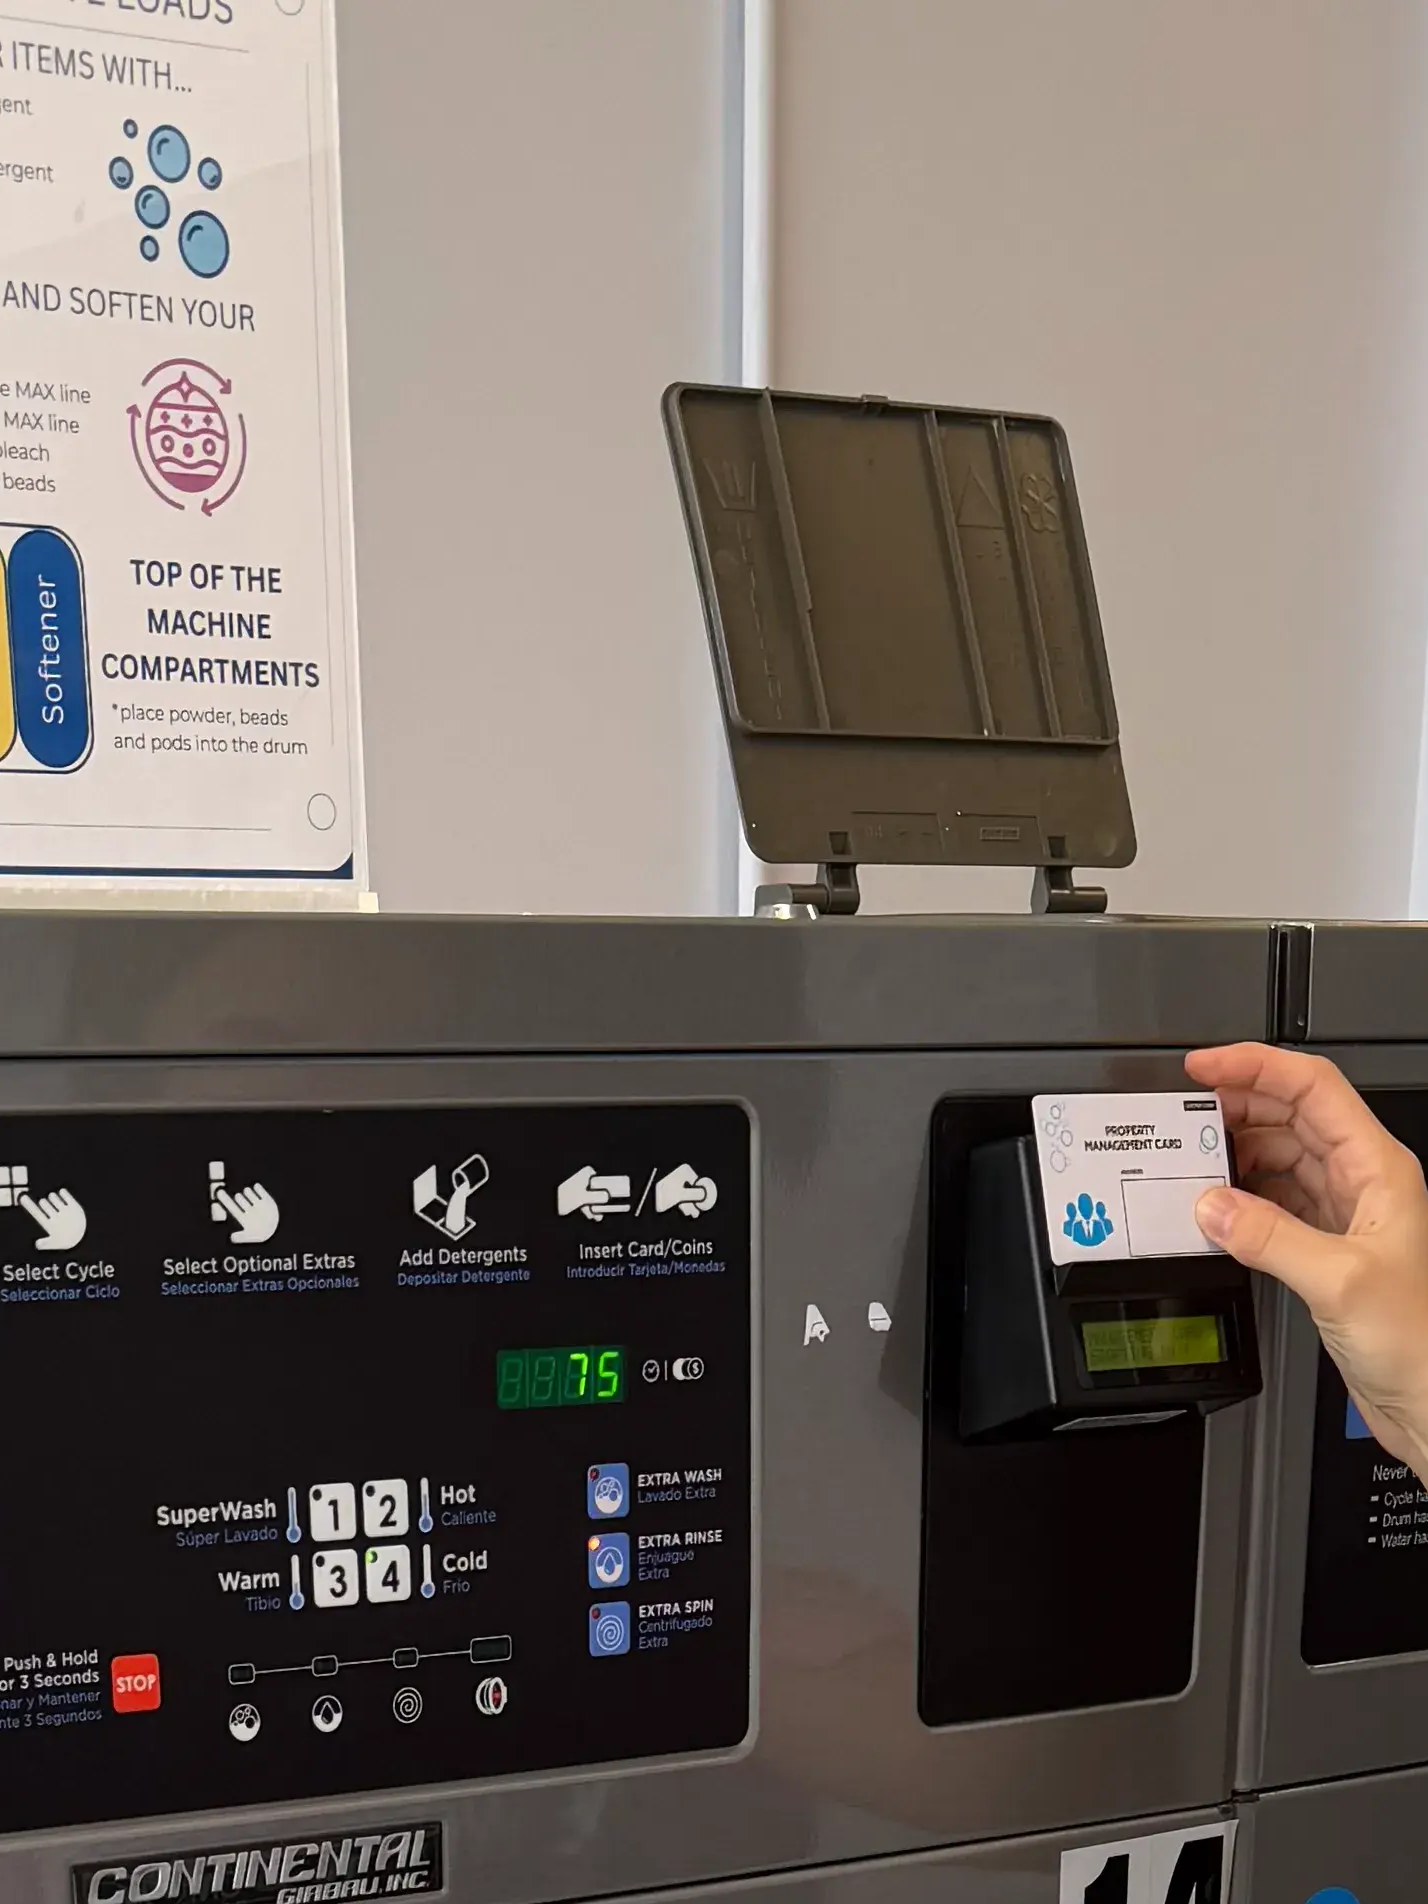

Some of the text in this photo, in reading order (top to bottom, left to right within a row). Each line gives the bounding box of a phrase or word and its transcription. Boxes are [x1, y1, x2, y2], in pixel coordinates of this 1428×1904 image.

[12, 40, 95, 80] ITEMS
[2, 280, 61, 312] AND
[69, 286, 174, 324] SOFTEN
[181, 297, 255, 332] YOUR
[15, 380, 56, 402] MAX
[59, 383, 91, 404] line
[129, 559, 282, 594] TOP OF THE
[147, 608, 272, 640] MACHINE
[37, 573, 65, 726] Softener
[101, 653, 320, 688] COMPARTMENTS
[169, 706, 236, 727] powder,
[239, 707, 289, 727] beads
[113, 732, 308, 755] and pods into the drum
[399, 1246, 528, 1267] Add Detergents
[579, 1238, 713, 1260] Insert Card/Coins
[2, 1260, 115, 1283] Select Cycle
[163, 1253, 356, 1276] Select Optional Extras
[570, 1352, 621, 1398] 75
[637, 1468, 722, 1488] EXTRA WASH
[440, 1484, 477, 1505] Hot
[156, 1498, 277, 1528] SuperWash
[326, 1497, 342, 1530] 1
[379, 1496, 397, 1527] 2
[638, 1529, 723, 1549] EXTRA RINSE
[442, 1550, 488, 1573] Cold
[217, 1570, 280, 1592] Warm
[330, 1563, 348, 1598] 3
[381, 1561, 401, 1594] 4
[638, 1598, 714, 1618] EXTRA SPIN
[3, 1648, 99, 1672] Push & Hold
[19, 1674, 30, 1690] 3
[33, 1668, 100, 1688] Seconds
[116, 1673, 157, 1694] STOP
